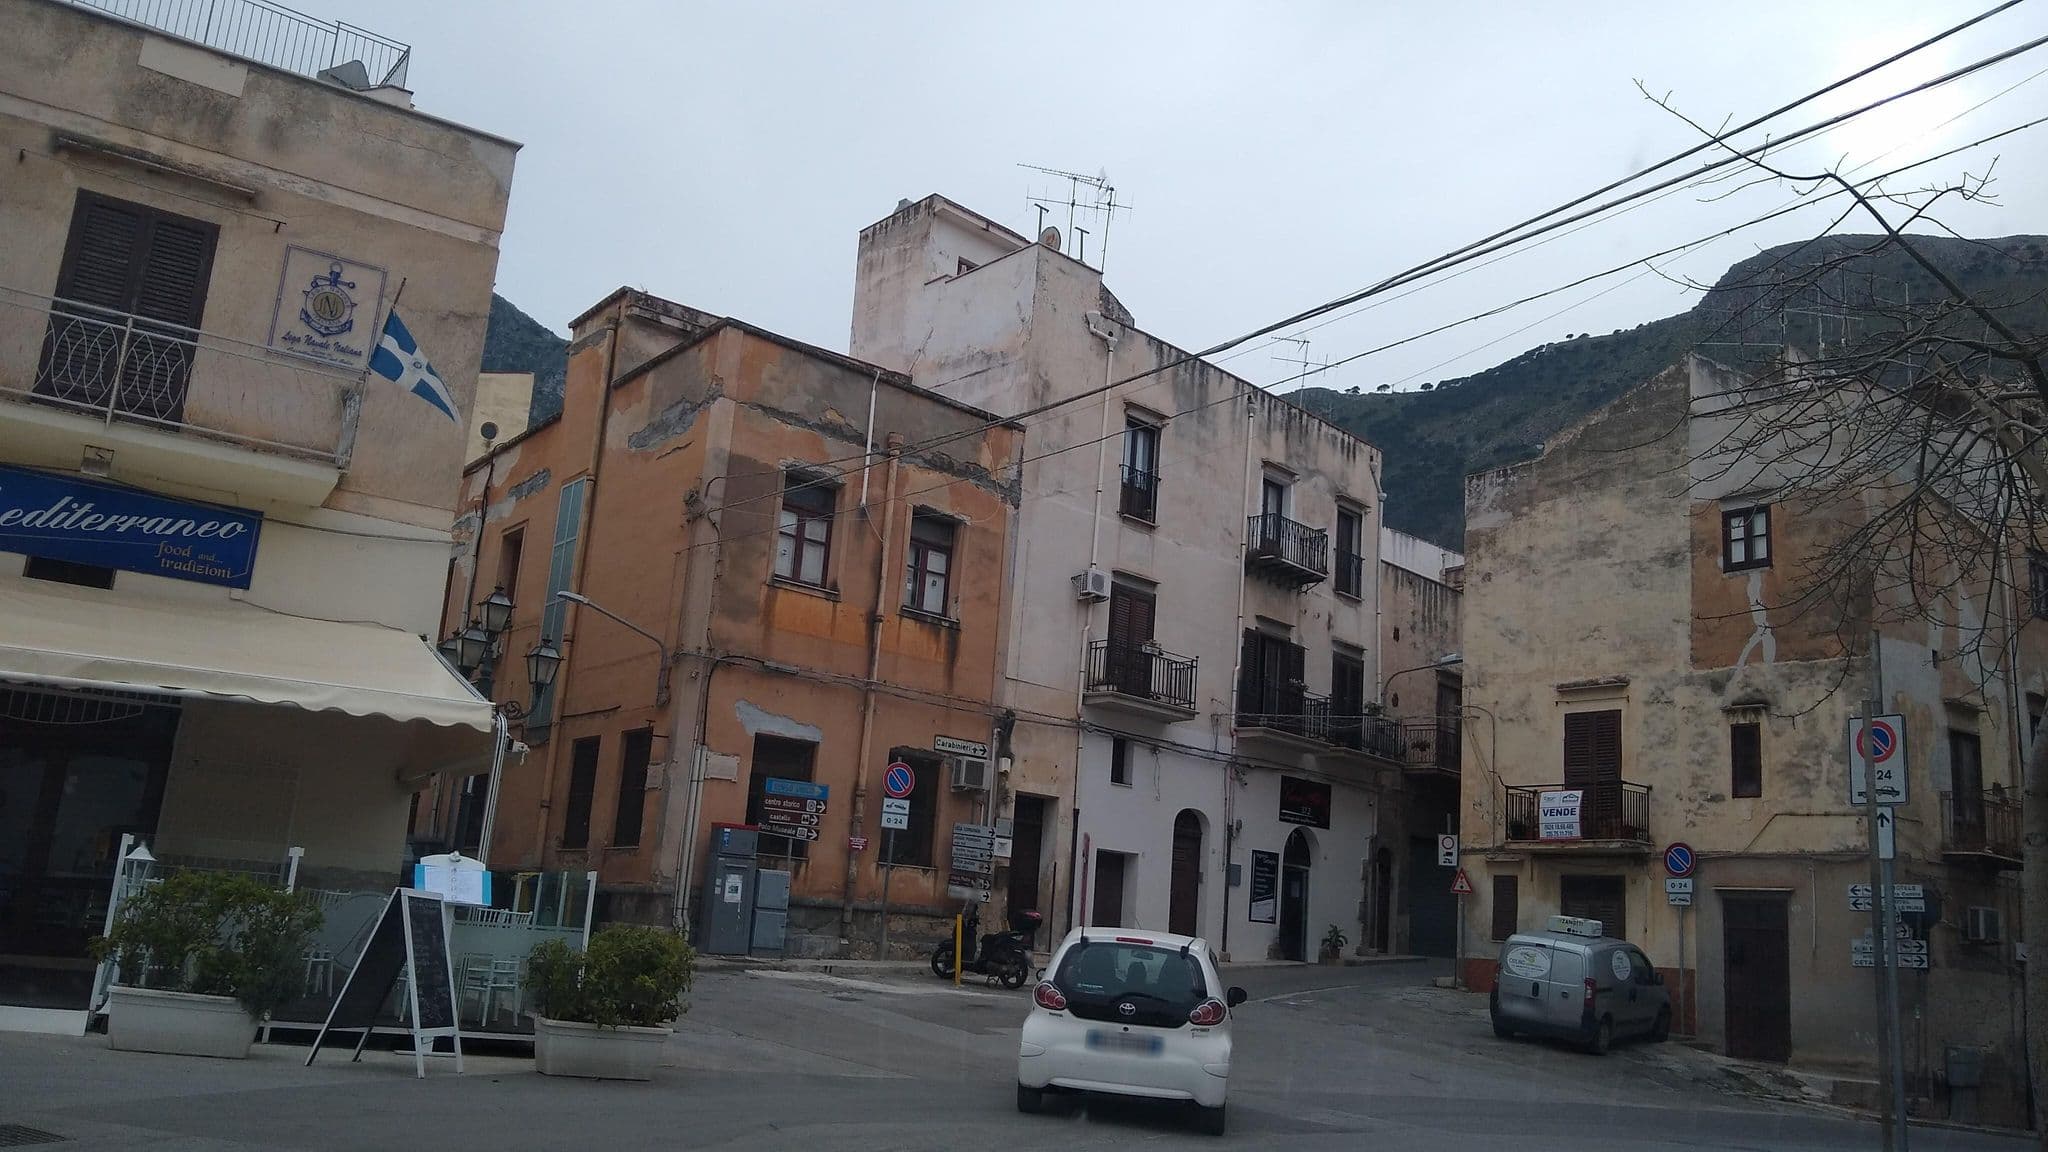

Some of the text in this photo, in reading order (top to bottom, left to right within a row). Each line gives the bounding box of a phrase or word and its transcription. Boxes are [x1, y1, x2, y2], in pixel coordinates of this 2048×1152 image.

[0, 493, 247, 539] editerraneo
[155, 541, 193, 558] food
[160, 557, 232, 579] tradizioni
[936, 740, 971, 752] Carabinieri
[764, 798, 800, 808] centro storico
[1542, 807, 1577, 816] VENDE
